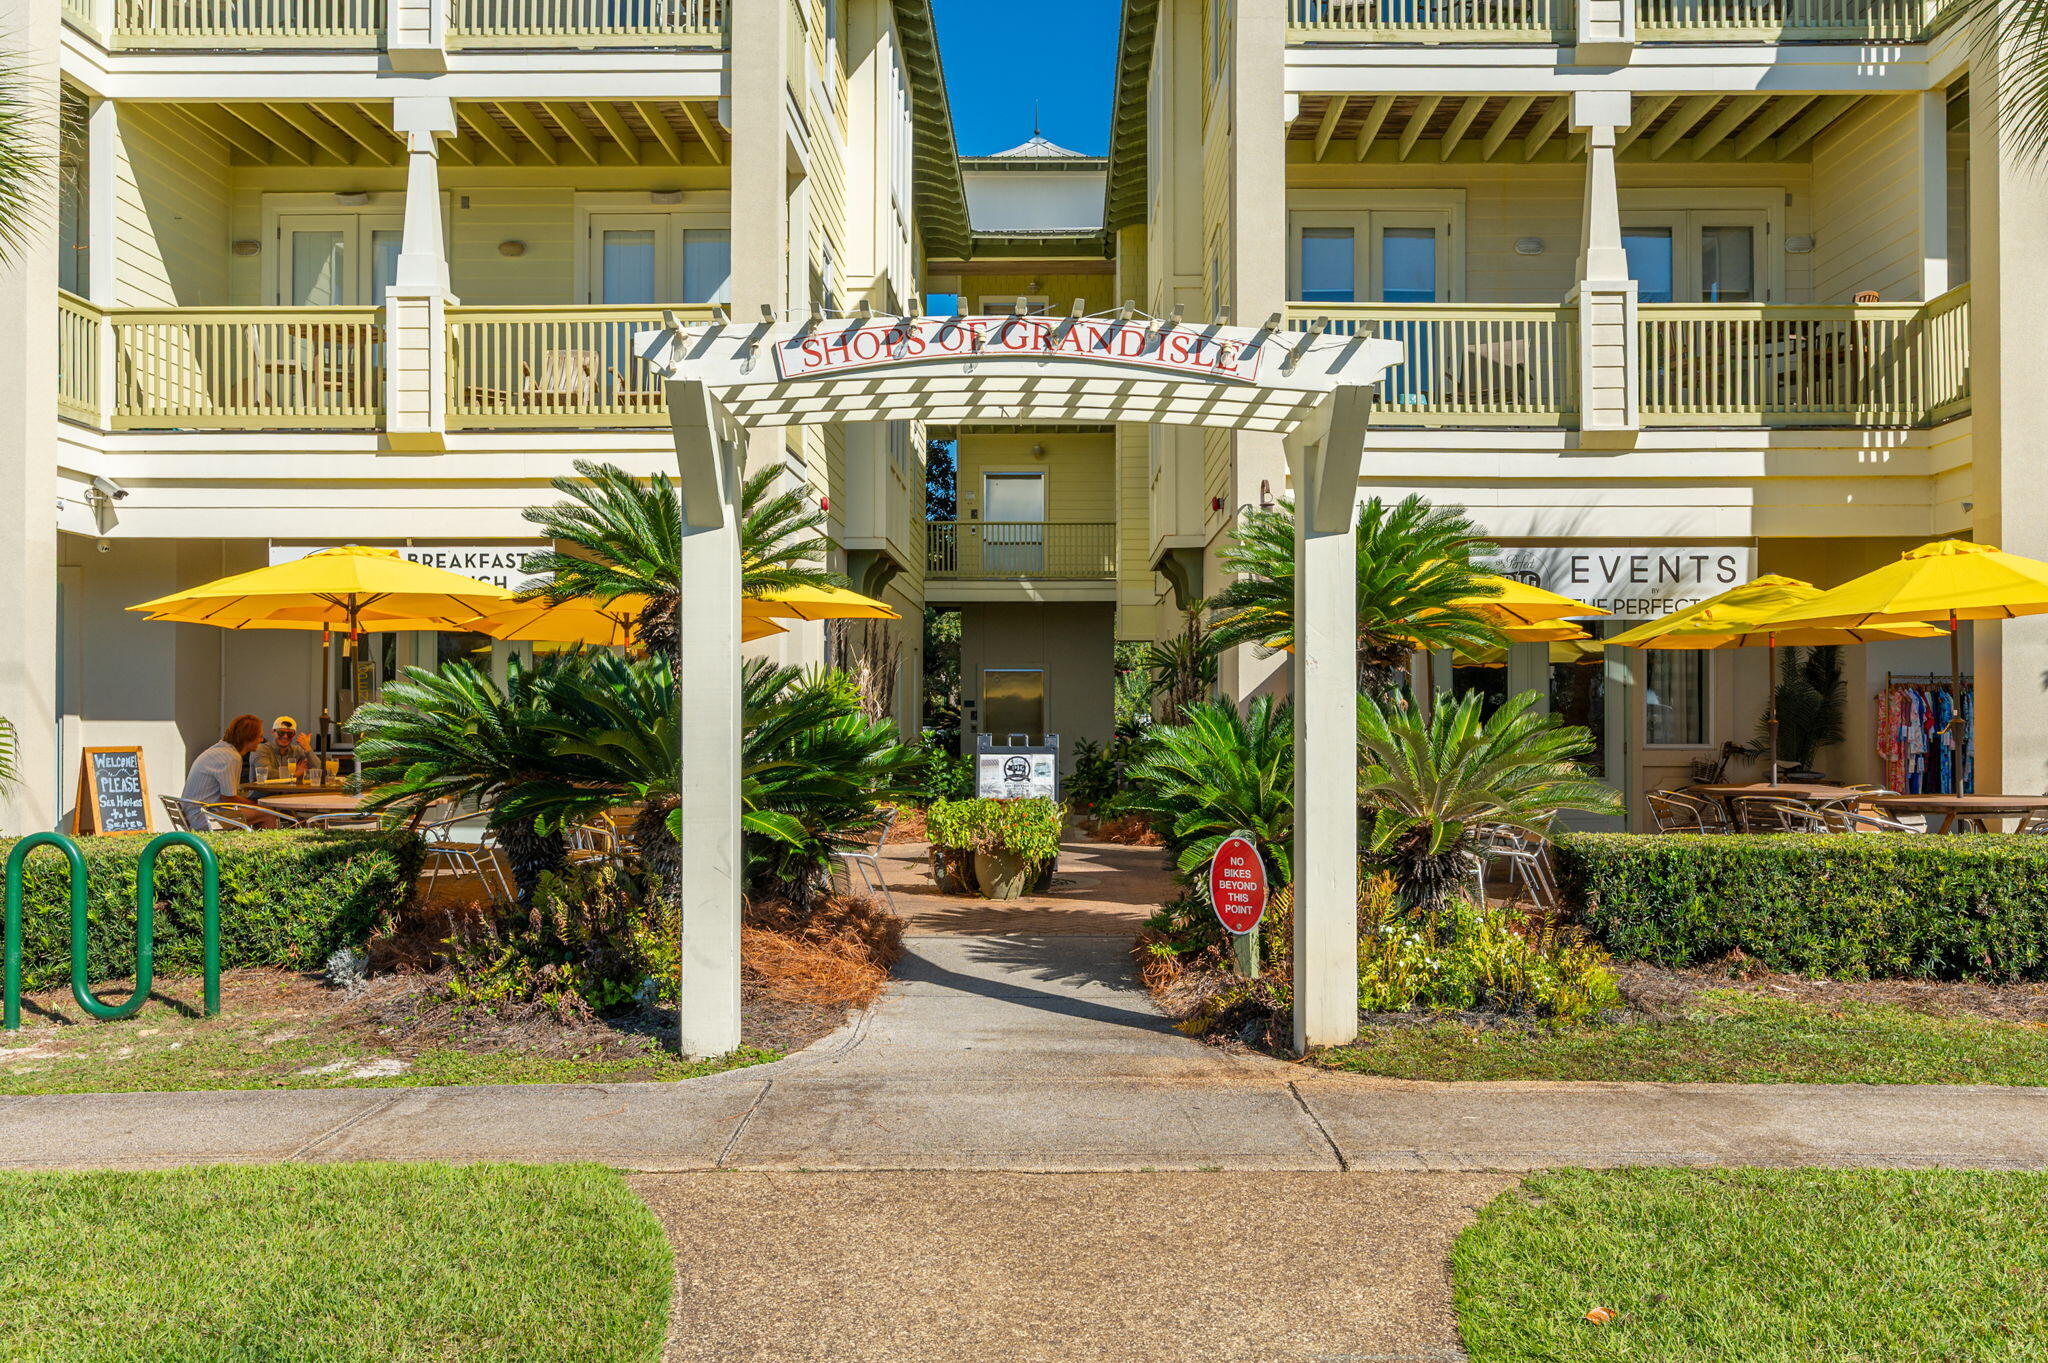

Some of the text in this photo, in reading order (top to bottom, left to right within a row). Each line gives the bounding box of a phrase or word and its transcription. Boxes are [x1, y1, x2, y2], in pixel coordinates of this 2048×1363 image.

[801, 320, 1246, 372] SHOPS OF GRAND ISLE
[1571, 555, 1737, 584] EVENTS
[1651, 587, 1660, 595] BY
[94, 753, 138, 769] WELCOME!
[101, 777, 141, 793] PLEASE
[1230, 857, 1244, 866] NO
[1224, 868, 1252, 879] BIKES
[1219, 880, 1258, 891] BEYOND
[1227, 892, 1249, 903] THIS
[1225, 904, 1253, 915] POINT
